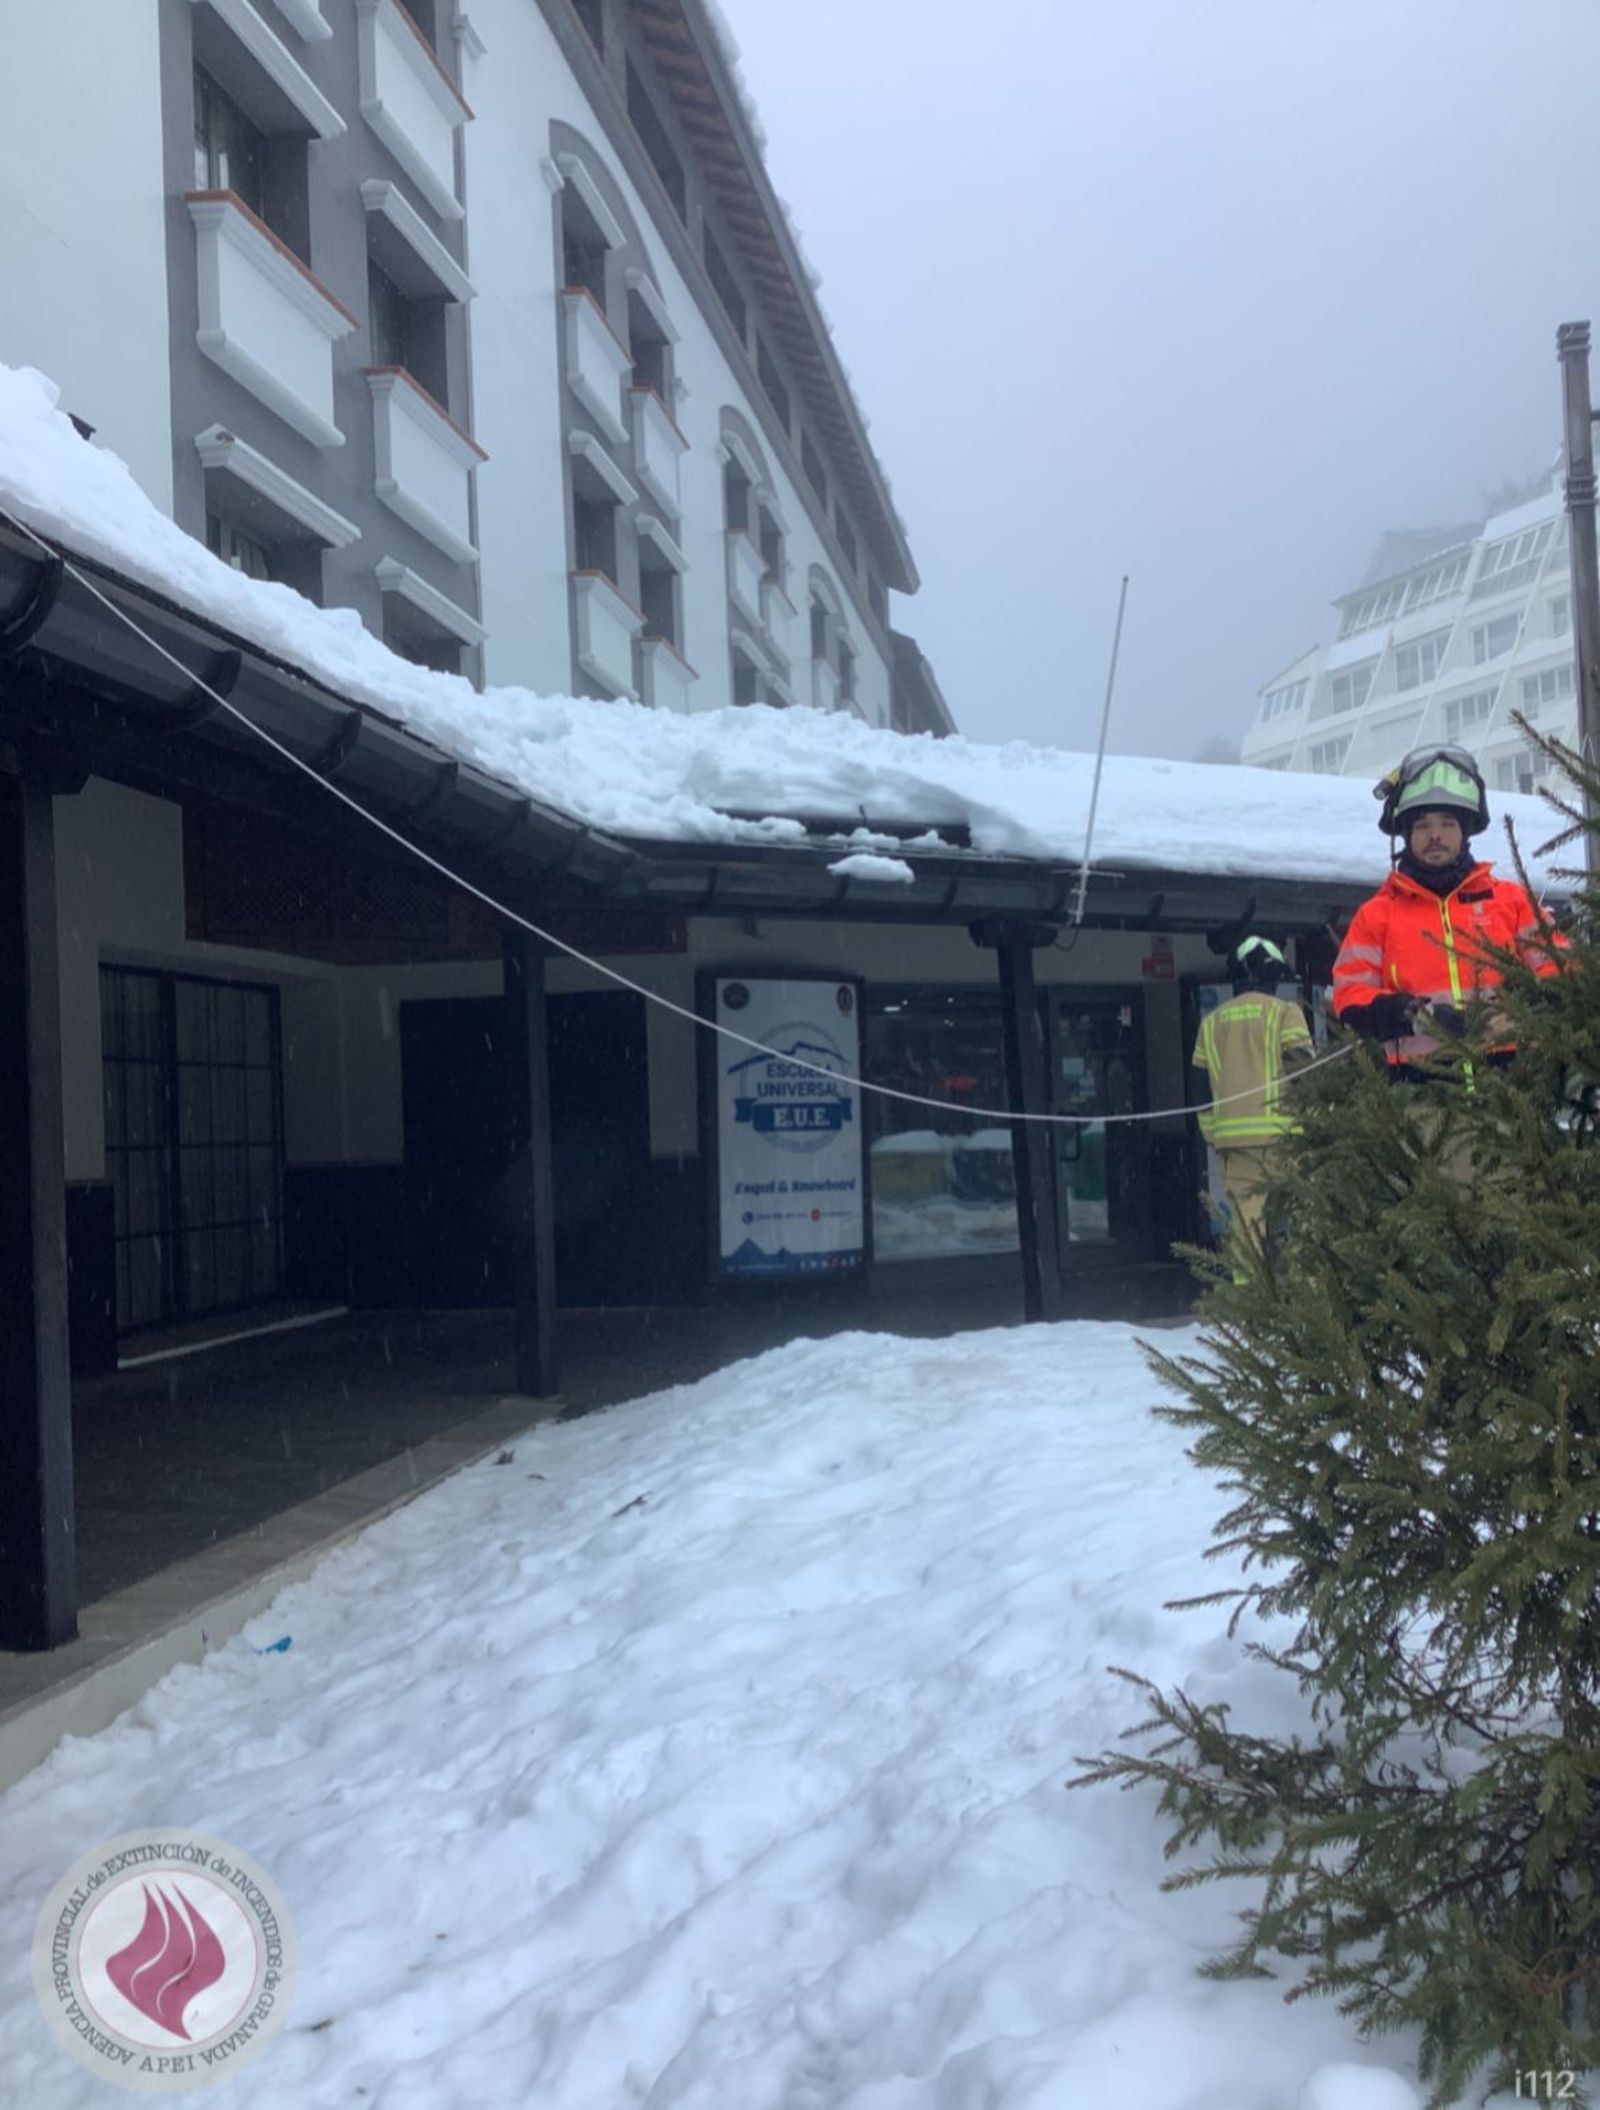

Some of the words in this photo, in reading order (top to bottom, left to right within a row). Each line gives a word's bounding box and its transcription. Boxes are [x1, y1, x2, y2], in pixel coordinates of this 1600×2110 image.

[756, 1081, 838, 1098] UNIVERSAL
[773, 1106, 831, 1128] E.U.E.
[778, 1179, 789, 1192] &
[791, 1177, 856, 1192] Snowboard
